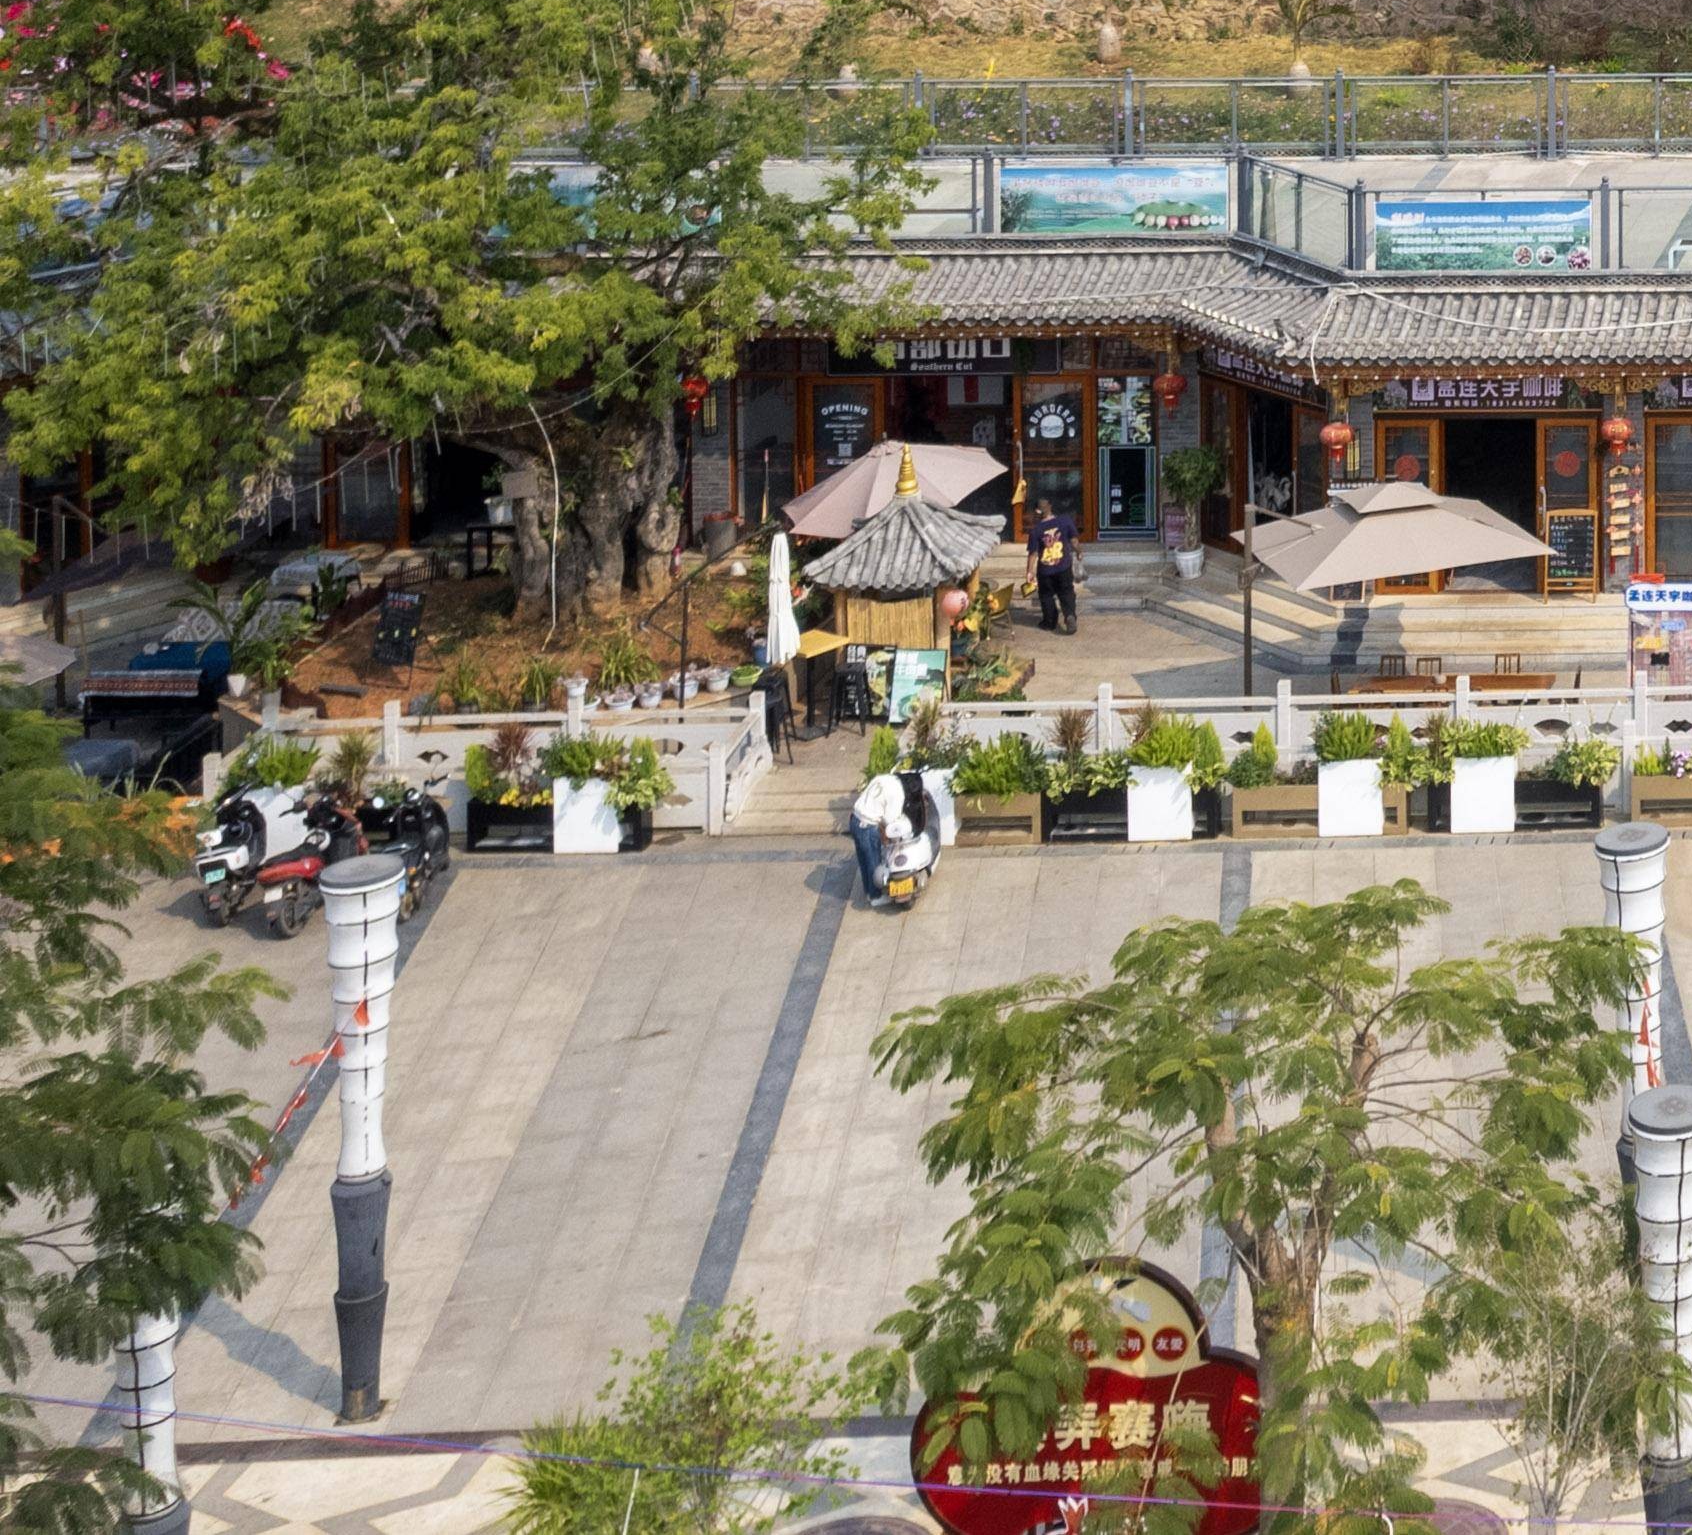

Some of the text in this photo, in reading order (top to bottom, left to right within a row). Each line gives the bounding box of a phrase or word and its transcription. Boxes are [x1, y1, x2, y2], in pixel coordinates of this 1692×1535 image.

[821, 403, 869, 416] OPENING
[1029, 403, 1075, 425] BURGERS
[1155, 1336, 1183, 1352] 友爱
